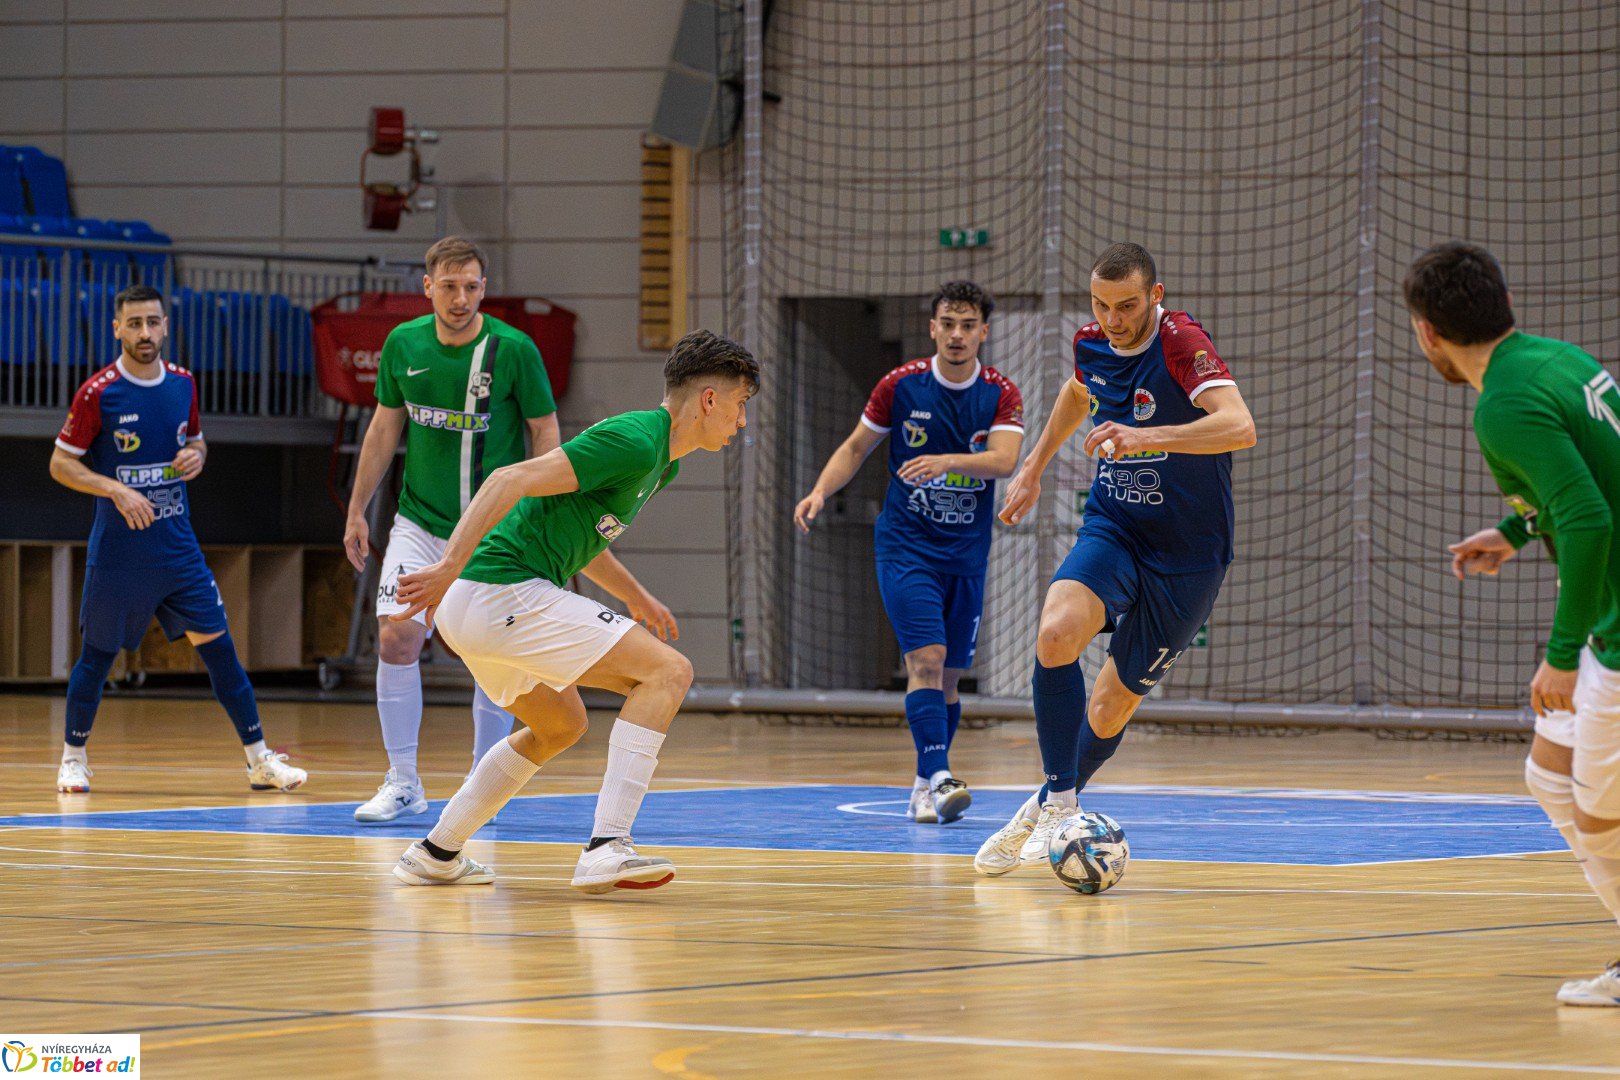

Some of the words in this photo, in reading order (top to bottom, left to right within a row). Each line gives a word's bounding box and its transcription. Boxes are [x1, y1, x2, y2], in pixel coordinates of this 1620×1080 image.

[1089, 373, 1107, 386] JAKO
[118, 413, 139, 424] JAKO
[910, 409, 932, 420] JAKO
[153, 503, 185, 520] UDIO
[906, 499, 975, 524] STUDIO
[923, 744, 946, 754] JAKO
